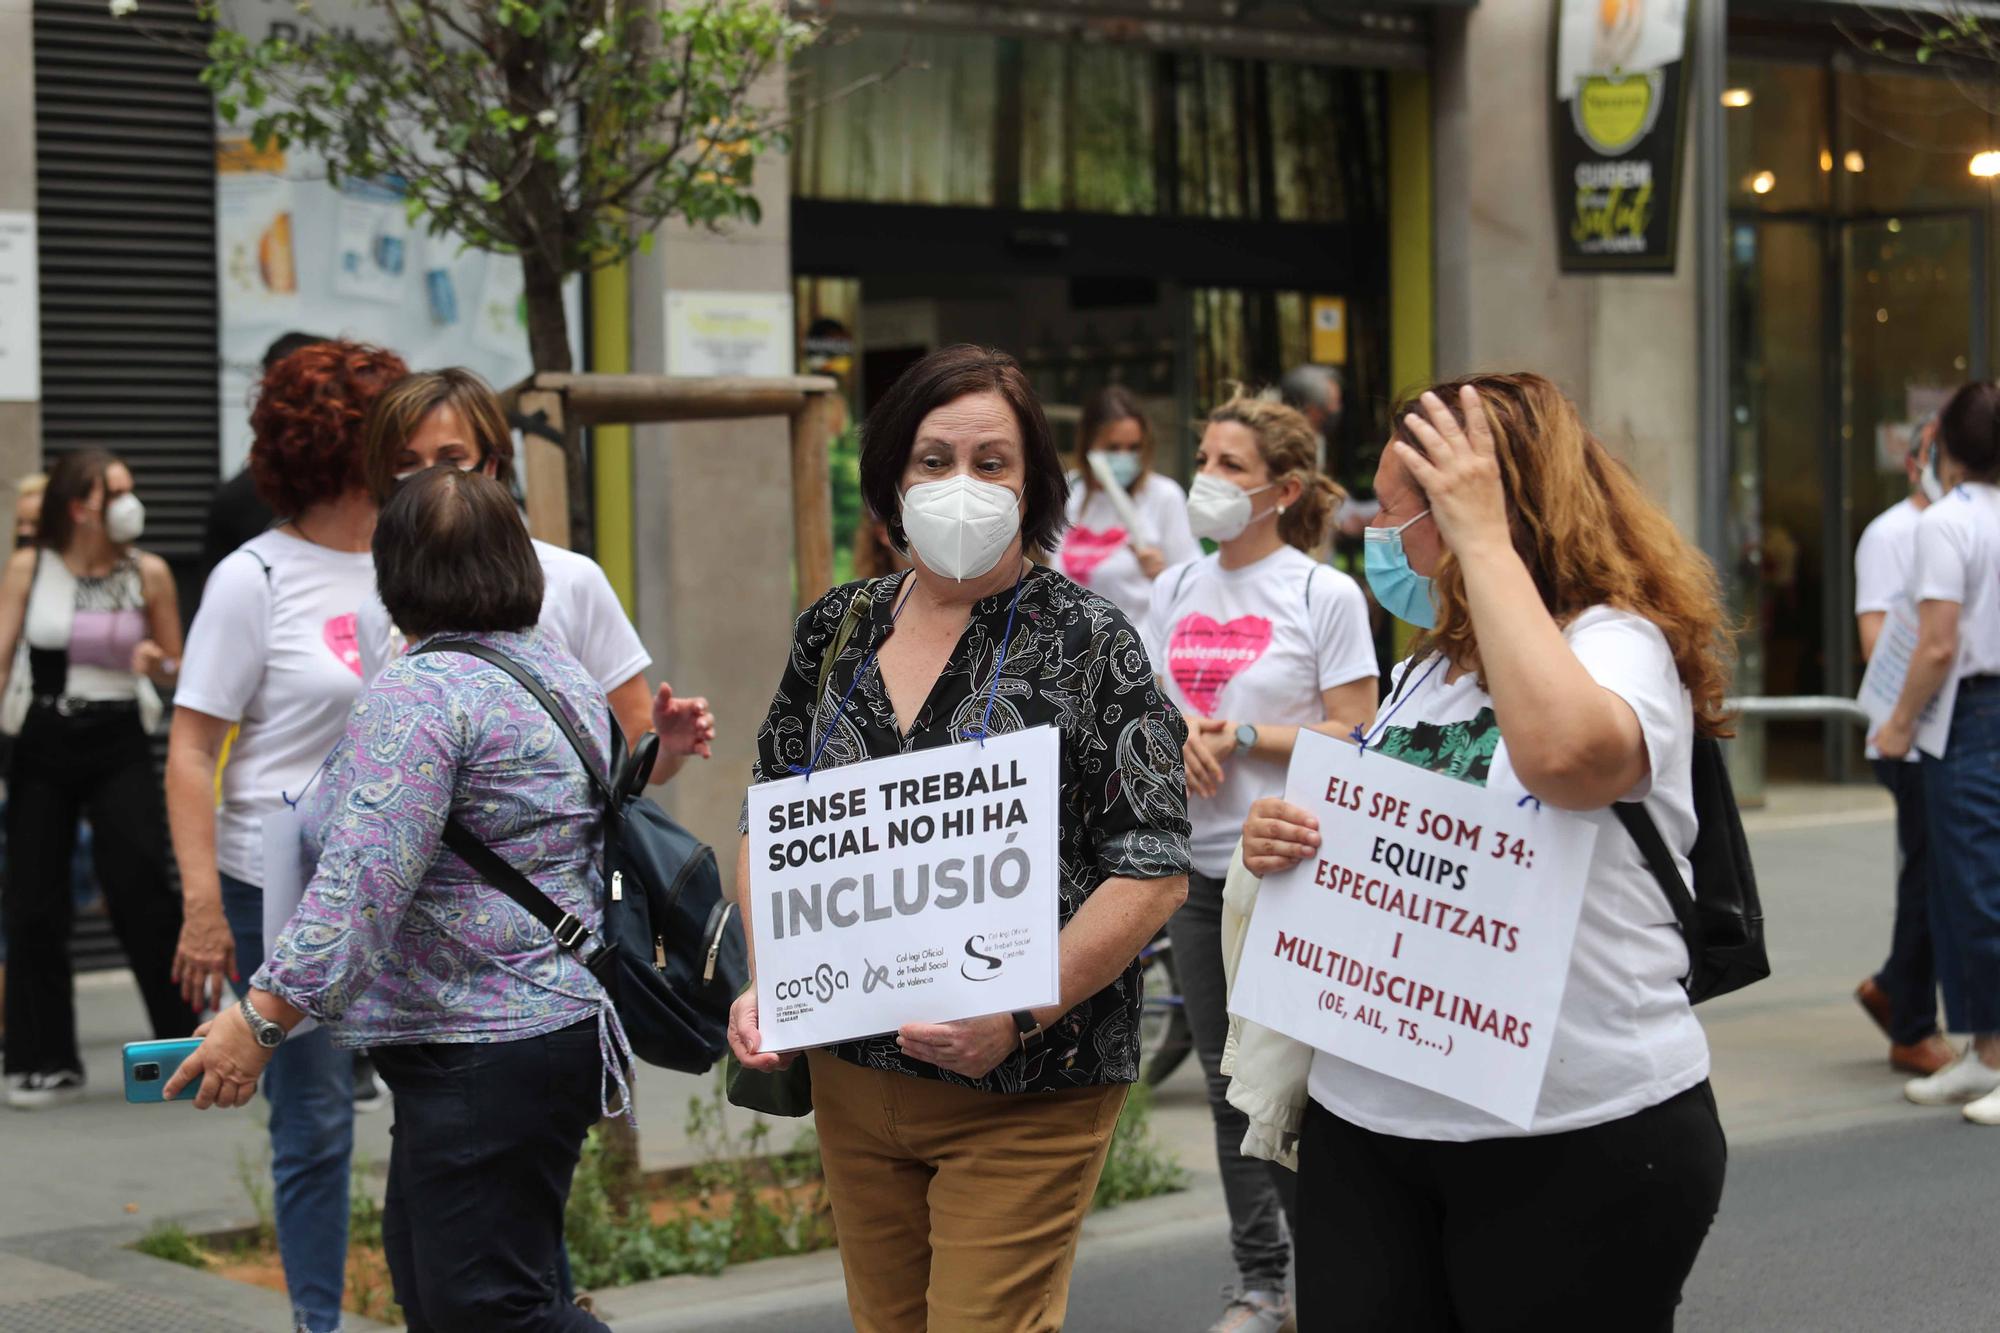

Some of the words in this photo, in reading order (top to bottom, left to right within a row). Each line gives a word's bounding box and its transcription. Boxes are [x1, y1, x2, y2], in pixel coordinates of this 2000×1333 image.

[768, 788, 866, 834] SENSE
[879, 759, 1027, 810] TREBALL
[1324, 776, 1364, 812] ELS
[1368, 792, 1409, 828] SPE
[1416, 809, 1482, 851] SOM
[1490, 831, 1534, 869] 34:
[768, 826, 879, 872] SOCIAL
[888, 816, 935, 849] NO
[942, 809, 974, 839] HI
[983, 798, 1028, 832] HA
[1370, 836, 1468, 891] EQUIPS
[771, 831, 1031, 940] INCLUSIÓ
[1313, 859, 1520, 953] ESPECIALITZATS
[896, 967, 905, 976] de
[906, 962, 927, 974] Treball
[928, 958, 949, 971] Social
[1391, 932, 1402, 958] I
[897, 978, 906, 989] de
[1273, 931, 1532, 1048] MULTIDISCIPLINARS
[1353, 1004, 1389, 1035] AIL,
